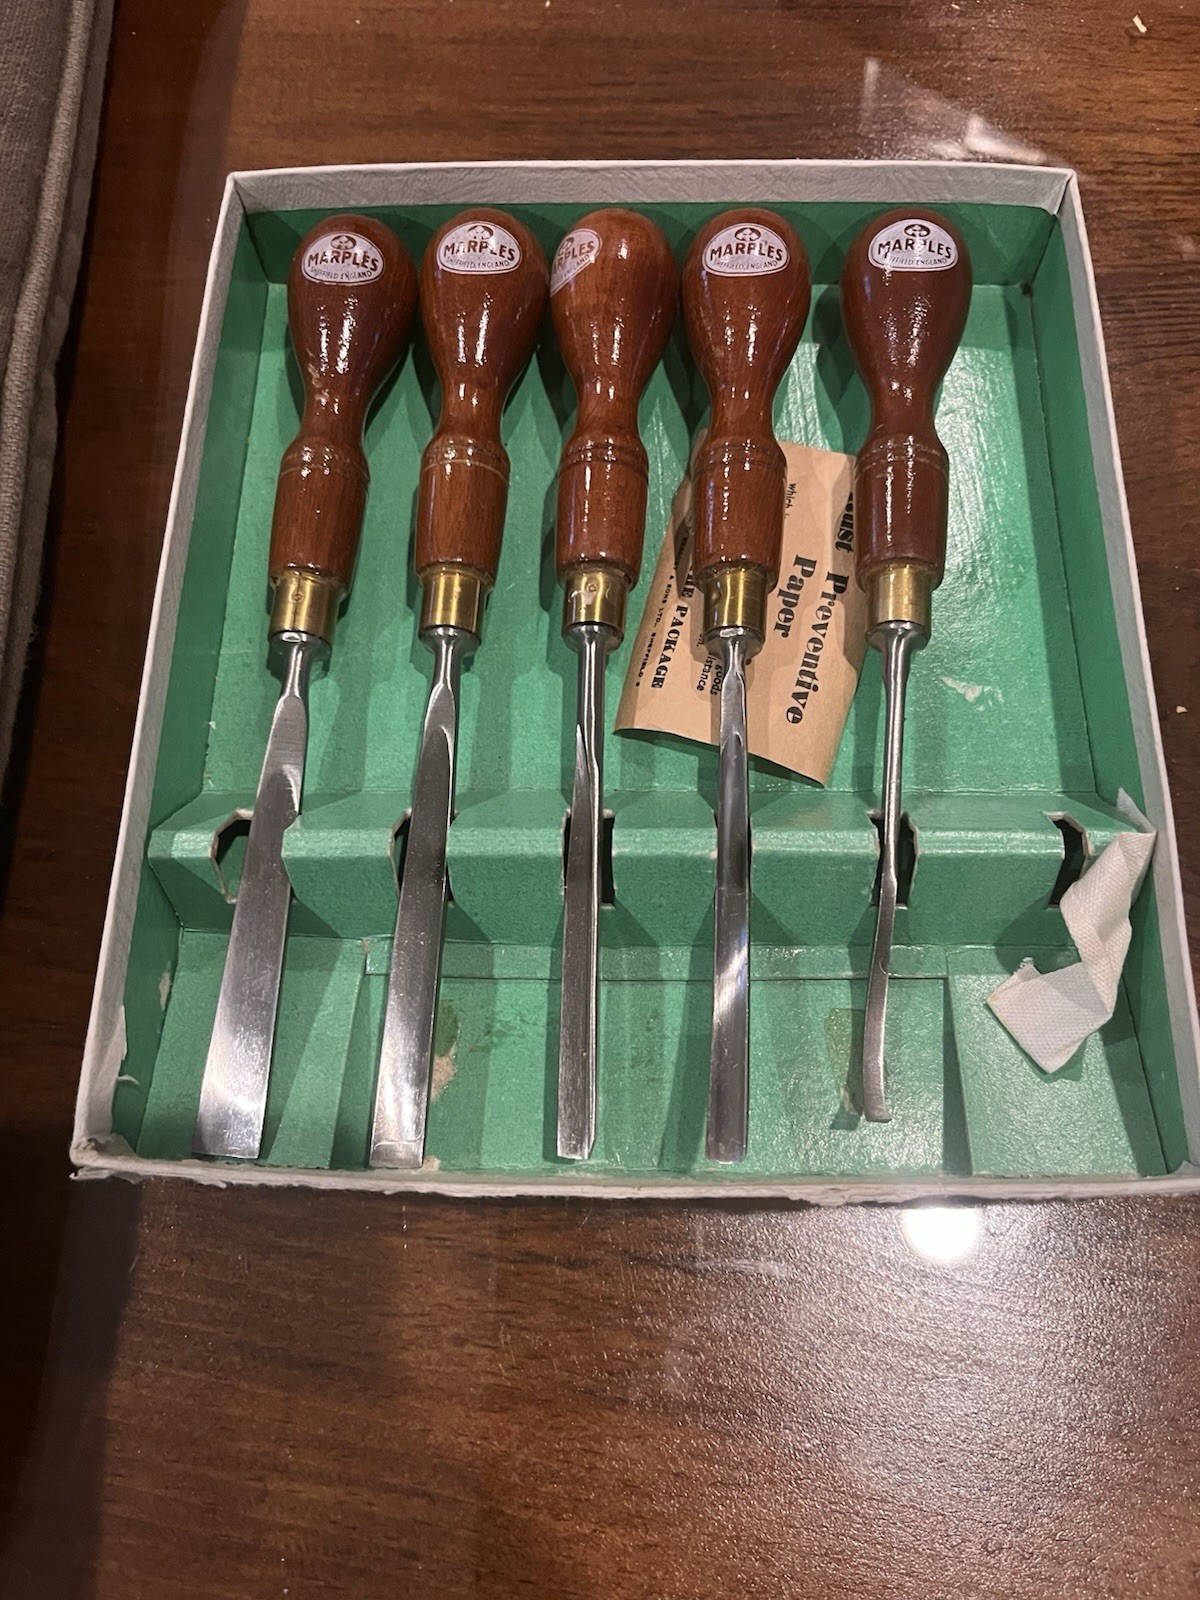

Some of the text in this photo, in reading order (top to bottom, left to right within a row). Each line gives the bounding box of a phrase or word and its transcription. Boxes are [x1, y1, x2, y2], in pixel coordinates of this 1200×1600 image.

[307, 250, 379, 272] MARPLES
[444, 240, 516, 262] MARPLES
[553, 240, 596, 274] RPLES
[710, 242, 784, 261] MARPLES
[662, 584, 672, 604] SONS
[773, 554, 817, 638] Paper
[651, 605, 689, 689] PACKAGE
[786, 571, 850, 724] Preventive
